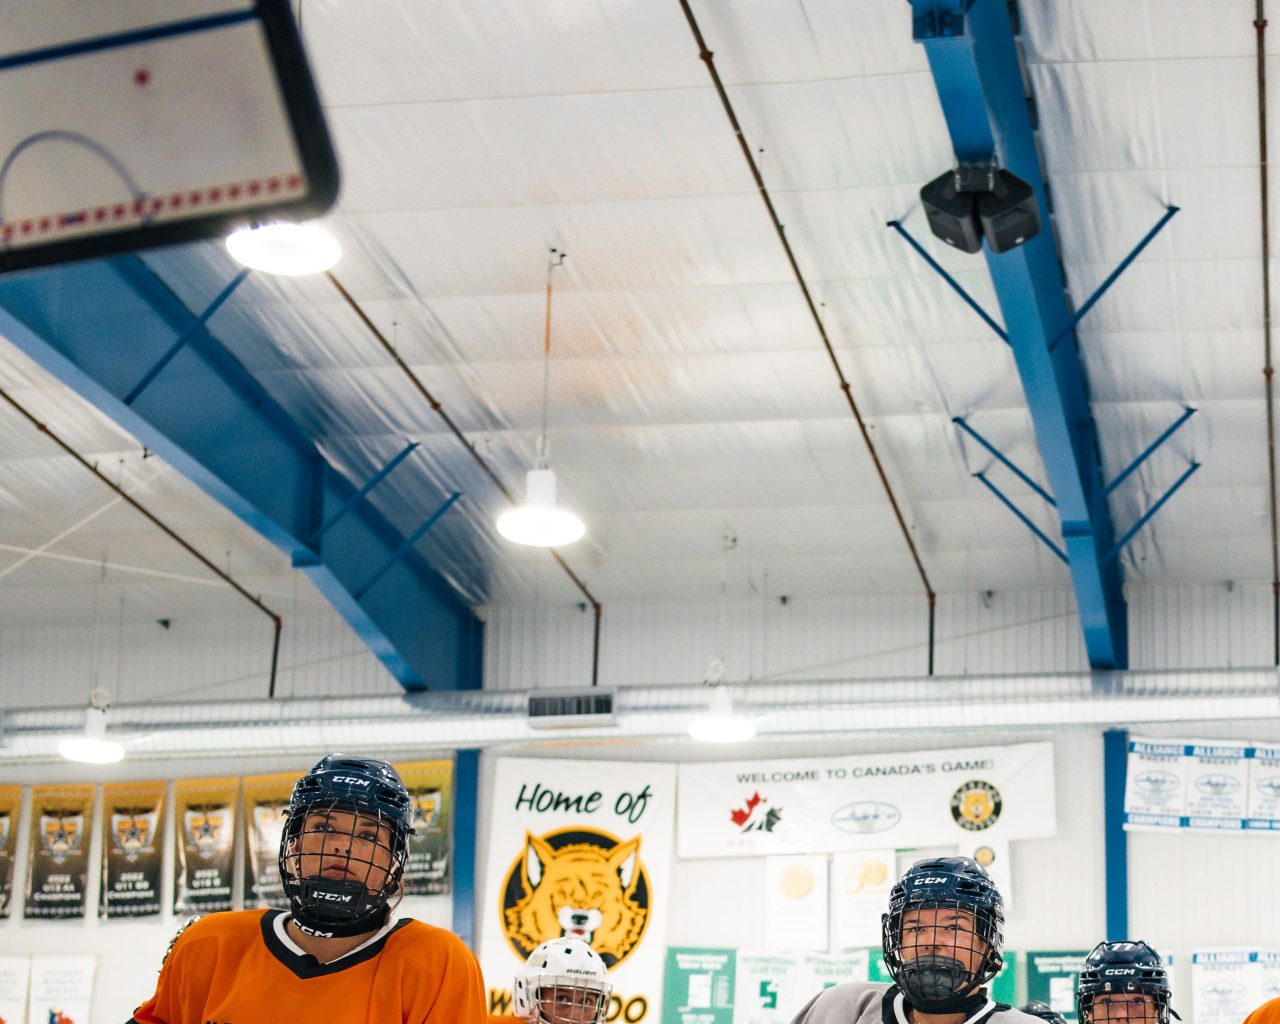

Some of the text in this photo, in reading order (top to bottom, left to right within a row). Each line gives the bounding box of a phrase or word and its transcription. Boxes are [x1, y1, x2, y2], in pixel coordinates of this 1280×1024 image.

[737, 759, 994, 784] WELCOME TO CANADA'S GAME!
[332, 775, 370, 787] CCM
[515, 783, 652, 824] Home of
[914, 876, 947, 886] CCM
[312, 890, 352, 903] CCM
[292, 918, 333, 938] CCM
[566, 968, 596, 976] BAUER
[1105, 968, 1136, 976] CCM
